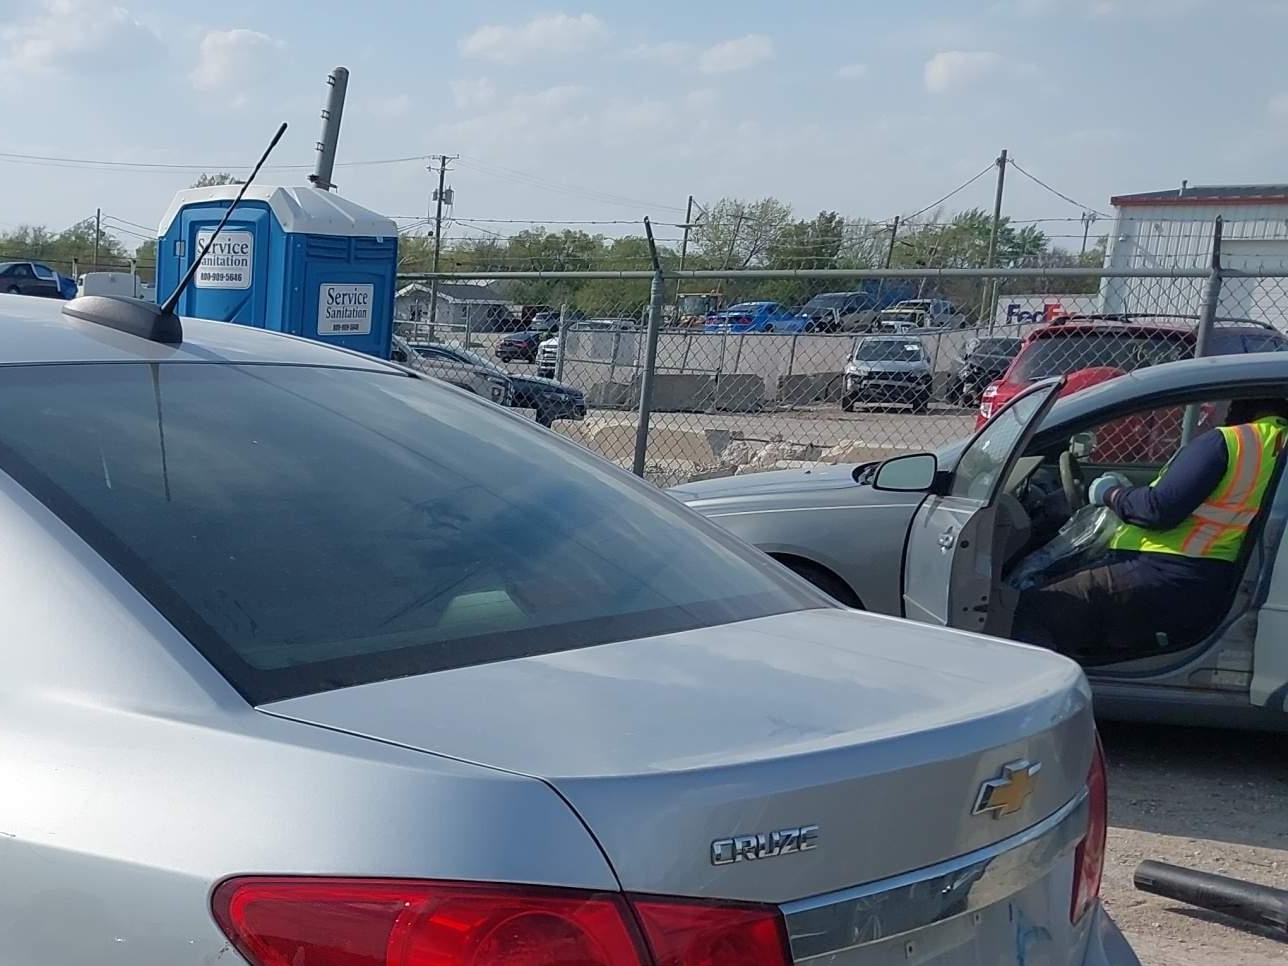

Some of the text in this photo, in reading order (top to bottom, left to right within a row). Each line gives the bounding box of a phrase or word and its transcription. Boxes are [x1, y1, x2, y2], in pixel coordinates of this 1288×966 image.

[197, 238, 249, 254] Srvice
[200, 255, 248, 267] anitation
[326, 287, 368, 305] Service
[325, 306, 367, 319] Sanitation
[711, 824, 819, 866] CRUZE
